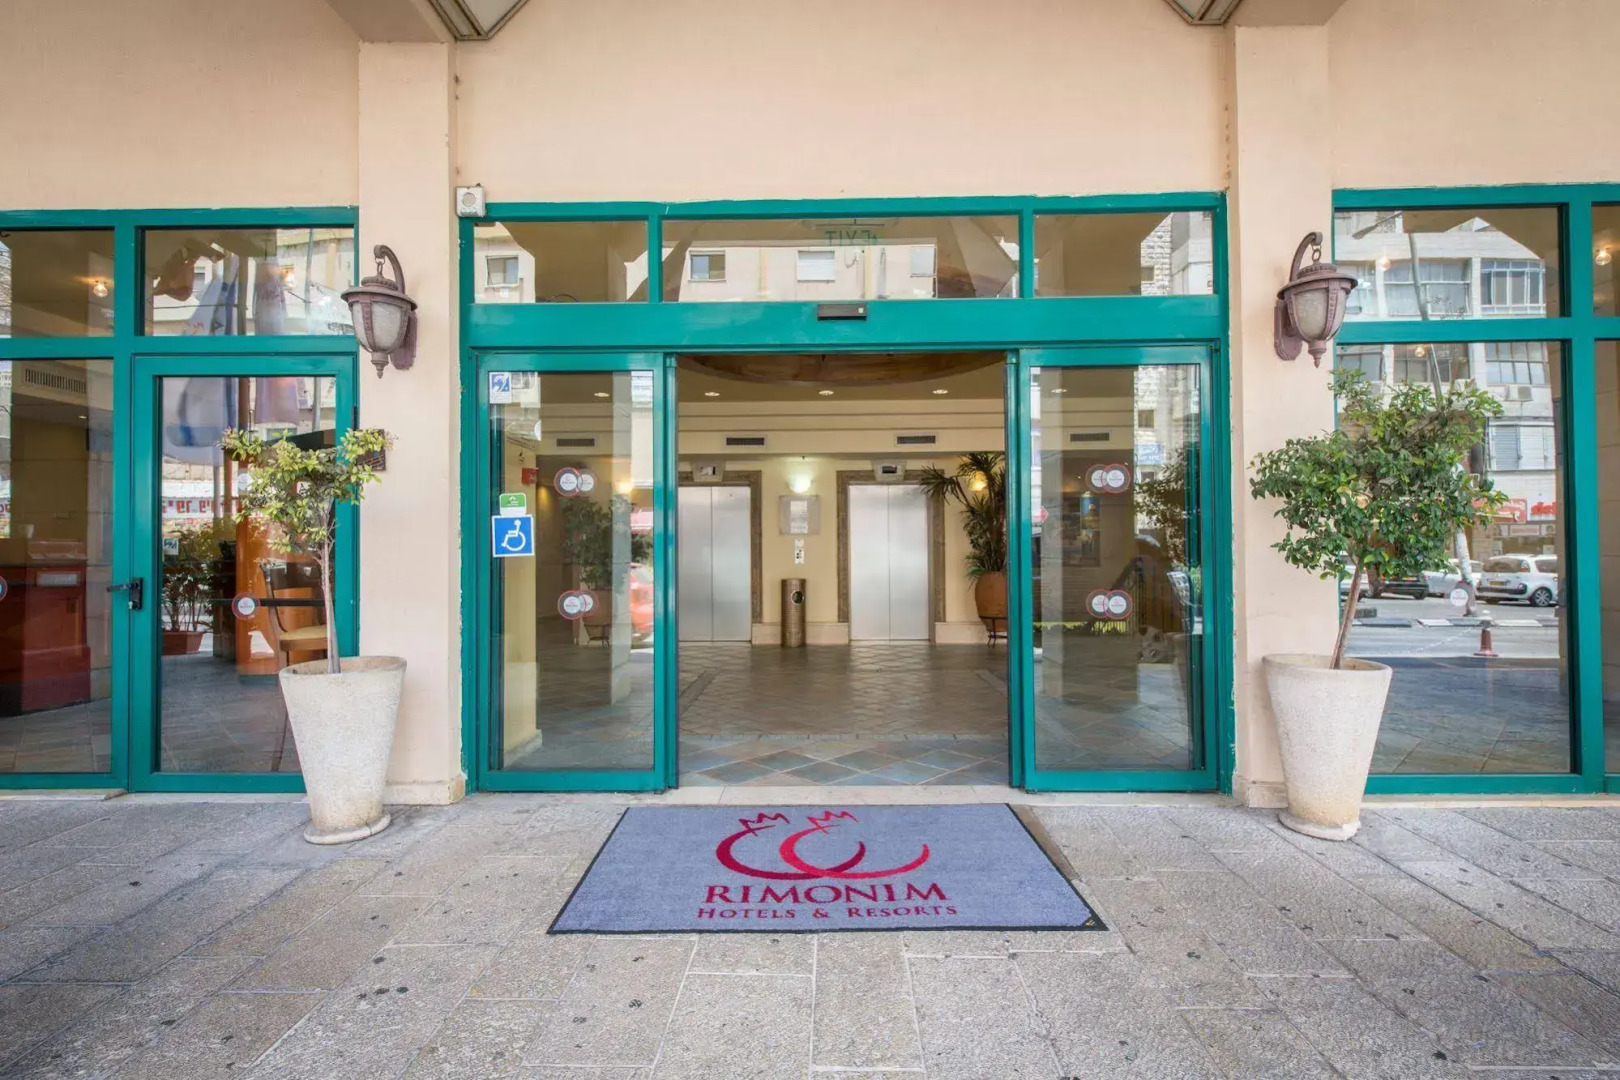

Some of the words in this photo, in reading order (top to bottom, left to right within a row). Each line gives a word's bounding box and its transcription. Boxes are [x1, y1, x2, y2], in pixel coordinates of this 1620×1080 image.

[703, 882, 951, 904] RIMONIM
[697, 907, 796, 919] HOTELS
[812, 907, 829, 918] &
[847, 905, 957, 918] RESORTS
